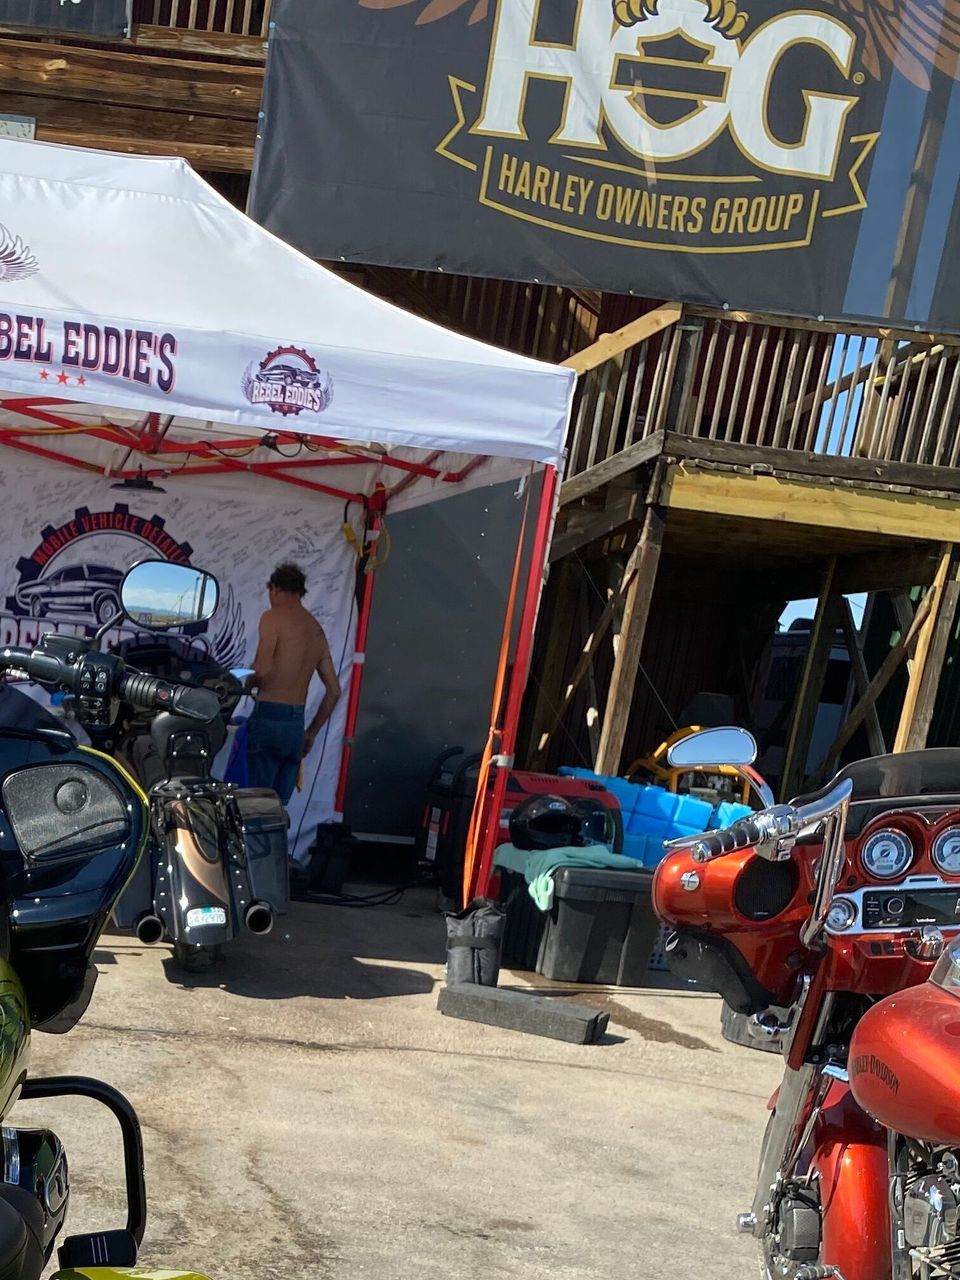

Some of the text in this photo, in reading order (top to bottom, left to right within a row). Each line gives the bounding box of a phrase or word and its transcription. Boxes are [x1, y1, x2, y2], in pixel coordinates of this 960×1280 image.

[467, 0, 859, 181] HOG
[498, 153, 804, 234] HARLEY OWNERS GROUP
[62, 321, 178, 394] EDDIE'S
[251, 381, 283, 403] REBEL
[31, 521, 79, 566] MOBILE
[81, 512, 139, 533] VEHICLE
